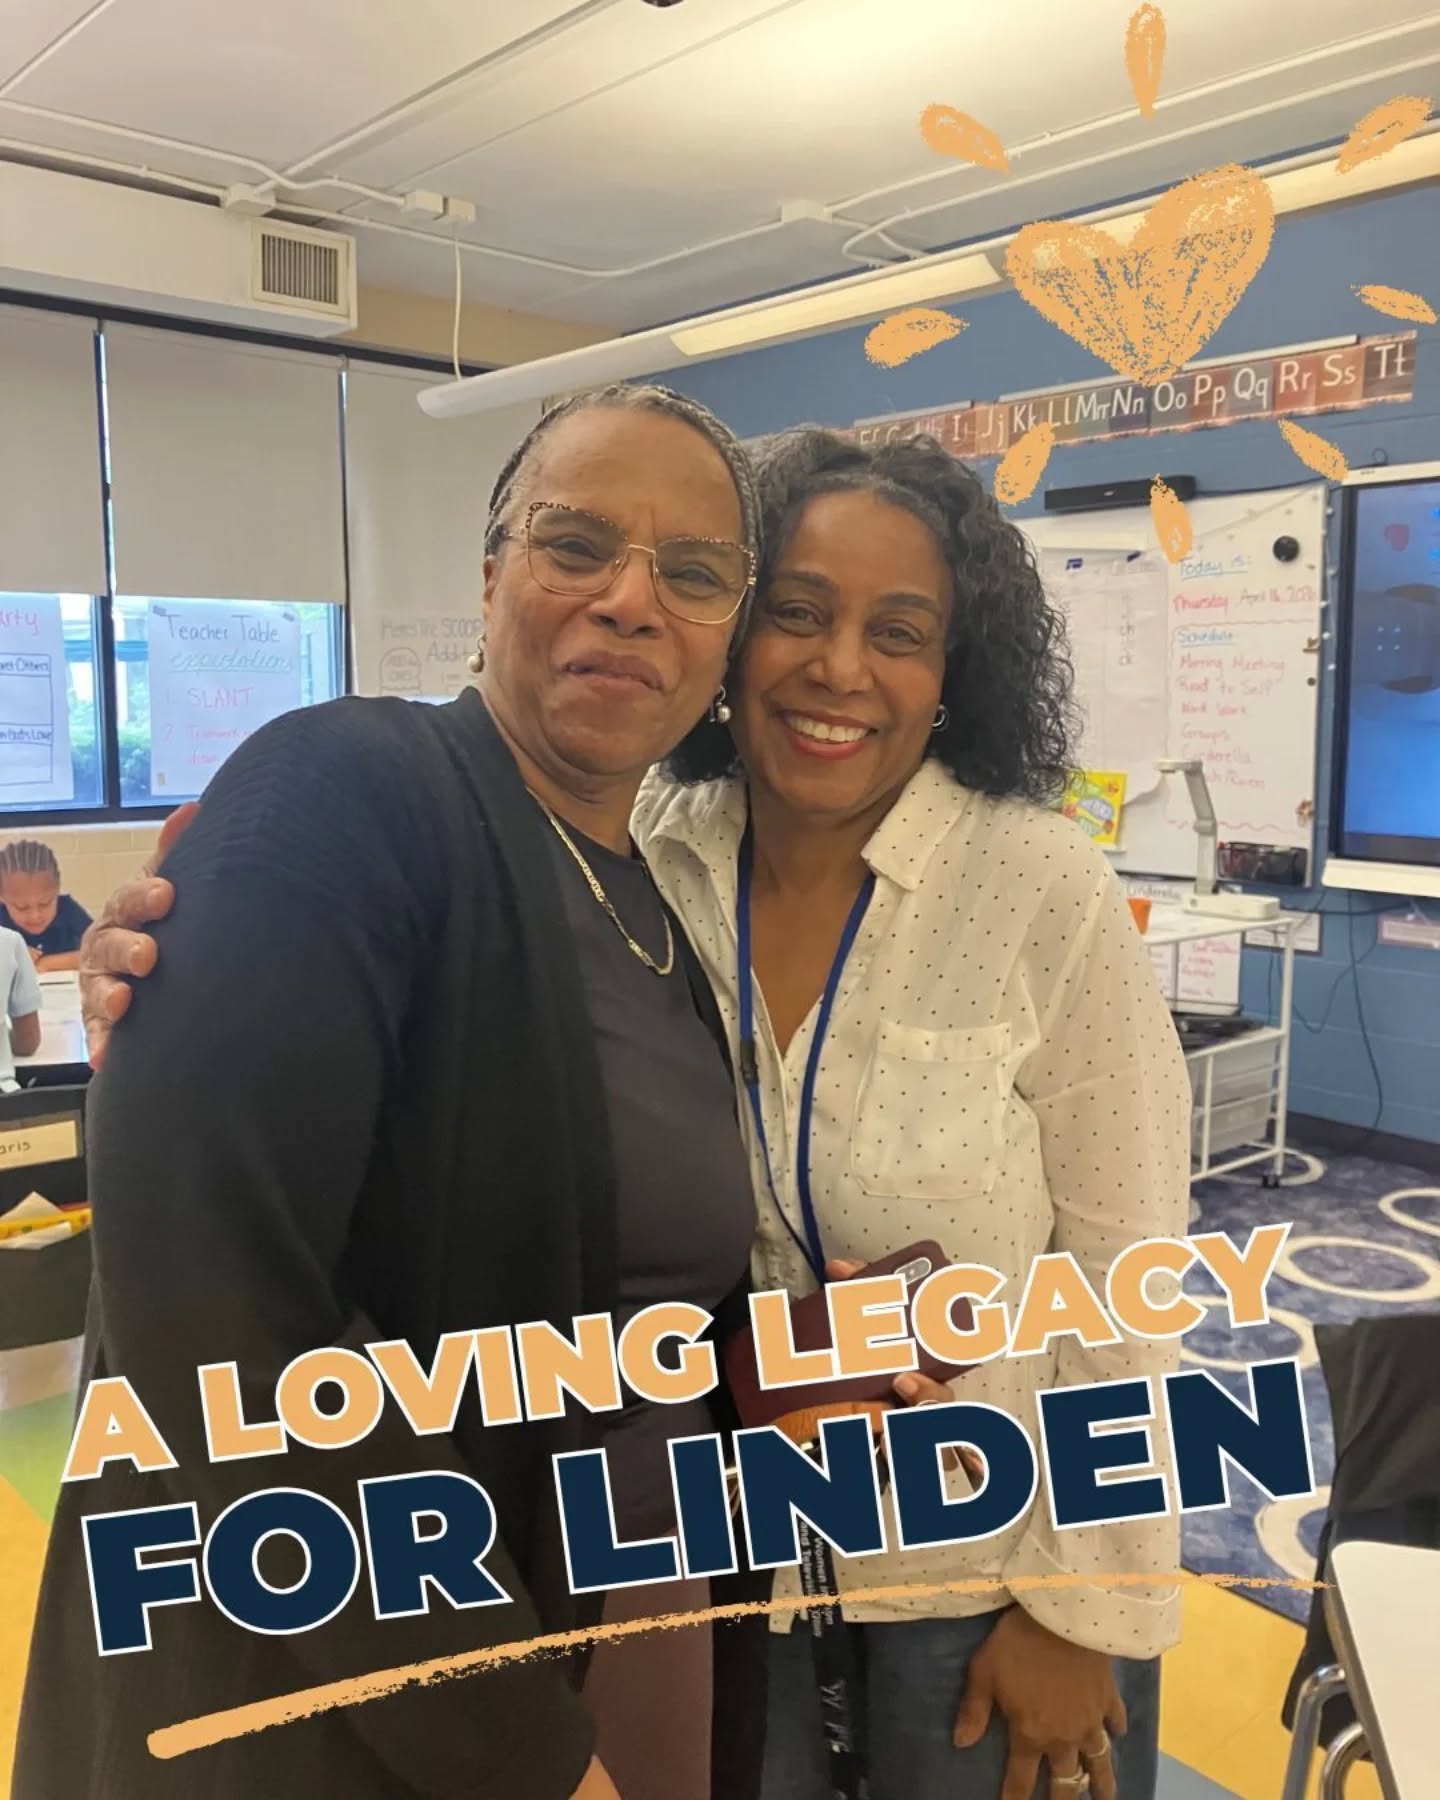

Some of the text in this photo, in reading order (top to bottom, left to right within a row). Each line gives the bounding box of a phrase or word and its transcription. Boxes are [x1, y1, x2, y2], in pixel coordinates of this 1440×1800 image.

[981, 408, 1004, 447] Jj
[1112, 387, 1144, 417] Nn
[1154, 382, 1187, 412] Oo
[1194, 374, 1226, 416] Pp
[1233, 368, 1268, 409] Qq
[1279, 361, 1313, 394] Rr
[1323, 354, 1356, 386] Ss
[1374, 343, 1406, 379] Tt
[1180, 556, 1222, 577] Today
[1173, 592, 1229, 616] Thursday
[160, 613, 281, 643] Teacher Table
[188, 688, 254, 708] SLANT
[800, 1521, 812, 1547] and
[813, 1536, 828, 1583] Women
